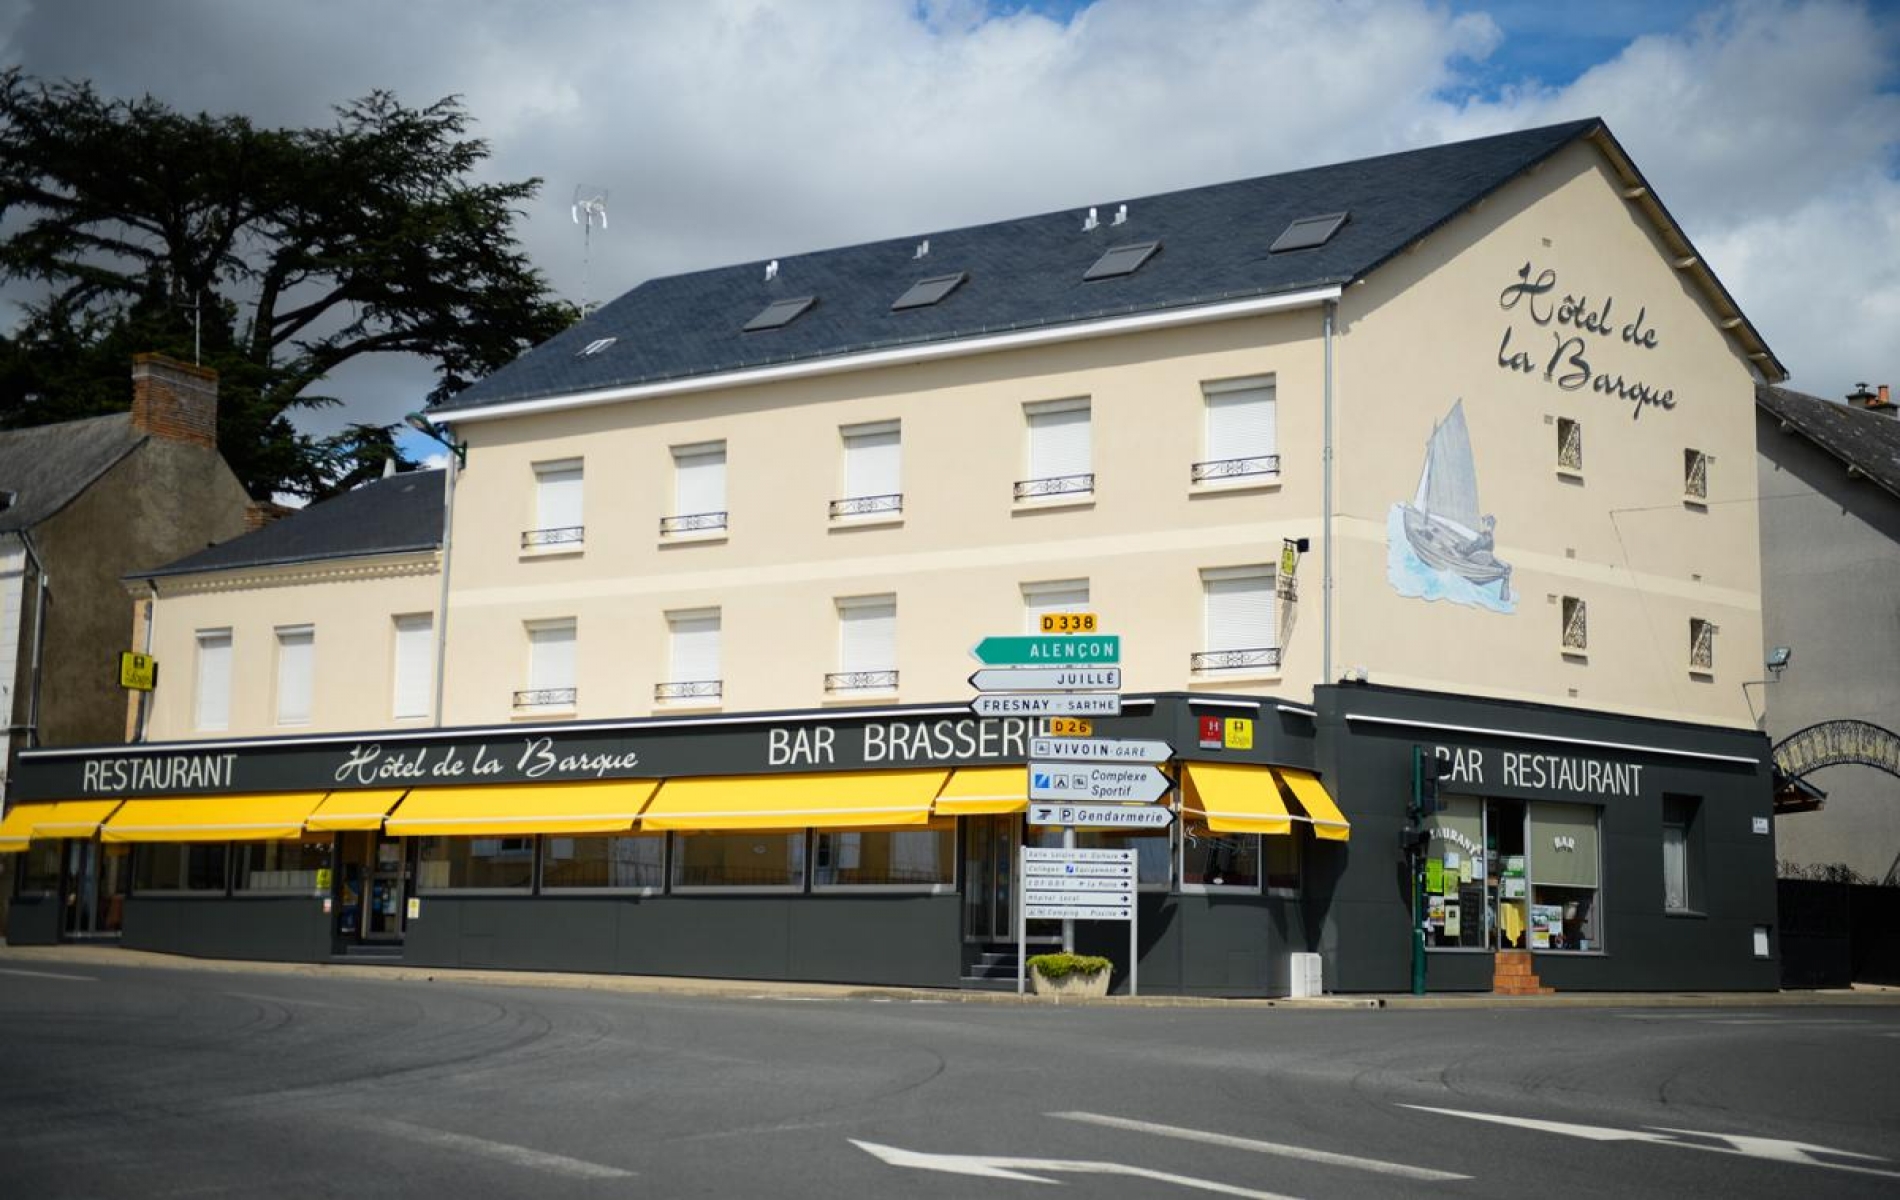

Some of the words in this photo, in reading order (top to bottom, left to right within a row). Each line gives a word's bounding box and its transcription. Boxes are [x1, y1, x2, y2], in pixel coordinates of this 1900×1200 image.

[1499, 261, 1613, 336] Hôtel
[1621, 306, 1659, 349] de
[1497, 325, 1535, 374] la
[1547, 330, 1677, 420] Barque
[1044, 616, 1054, 630] D
[1059, 615, 1093, 630] 338
[1029, 642, 1115, 660] ALENÇON
[1057, 671, 1115, 685] JUILLÉ
[982, 699, 1050, 711] FRESNAY
[1067, 700, 1115, 711] SARTHE
[1055, 720, 1063, 732] D
[1068, 720, 1088, 733] 26
[767, 726, 836, 766] BAR
[334, 743, 427, 785] Hôtel
[431, 745, 466, 777] de
[471, 743, 505, 775] la
[516, 736, 639, 778] Barque
[83, 753, 239, 793] RESTAURANT
[1091, 768, 1147, 783] Complexe
[1435, 746, 1484, 784] BAR
[1502, 752, 1643, 797] RESTAURANT
[1090, 785, 1132, 798] Sportif
[1077, 809, 1163, 823] Gendarmerie
[1554, 835, 1576, 850] BAR
